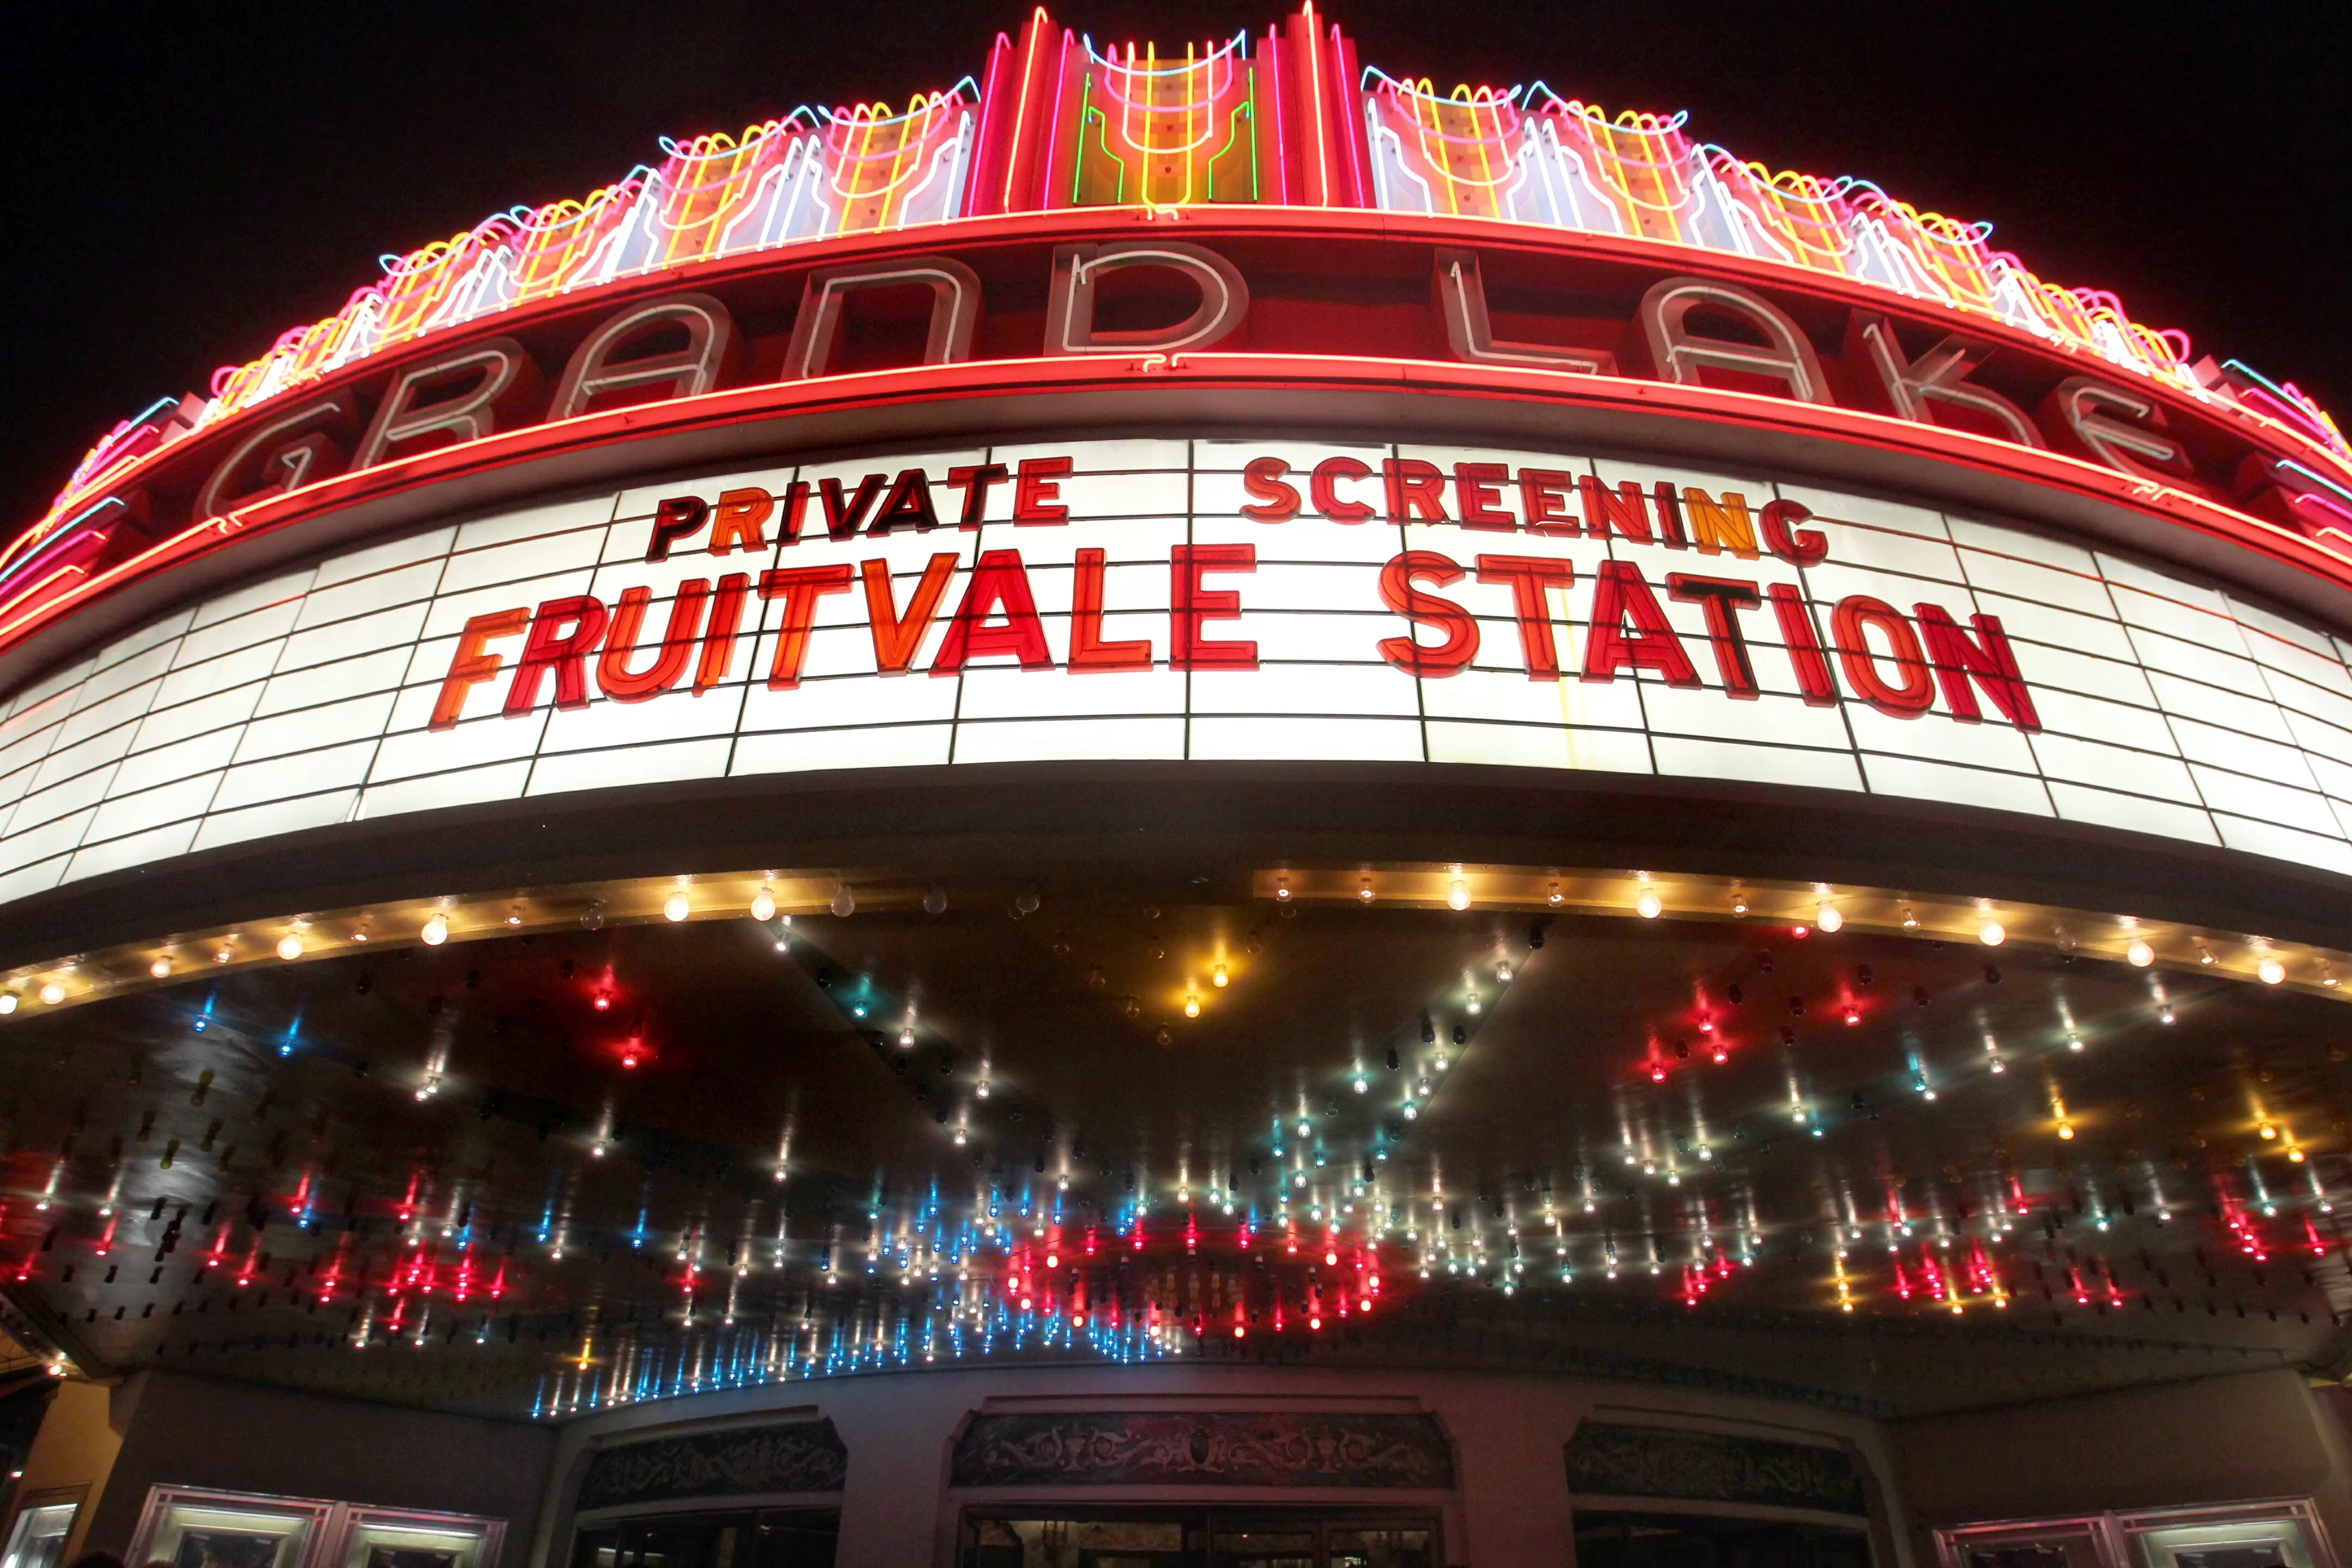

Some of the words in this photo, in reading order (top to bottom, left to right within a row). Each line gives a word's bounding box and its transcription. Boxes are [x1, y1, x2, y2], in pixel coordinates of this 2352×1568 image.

[193, 243, 1250, 517] GRAND
[1434, 248, 2197, 483] LAKE
[645, 456, 1074, 562] PRIVATE
[1242, 456, 1828, 567] SCREENING
[428, 543, 1260, 731] FRUITVALE
[1376, 550, 2043, 734] STATION
